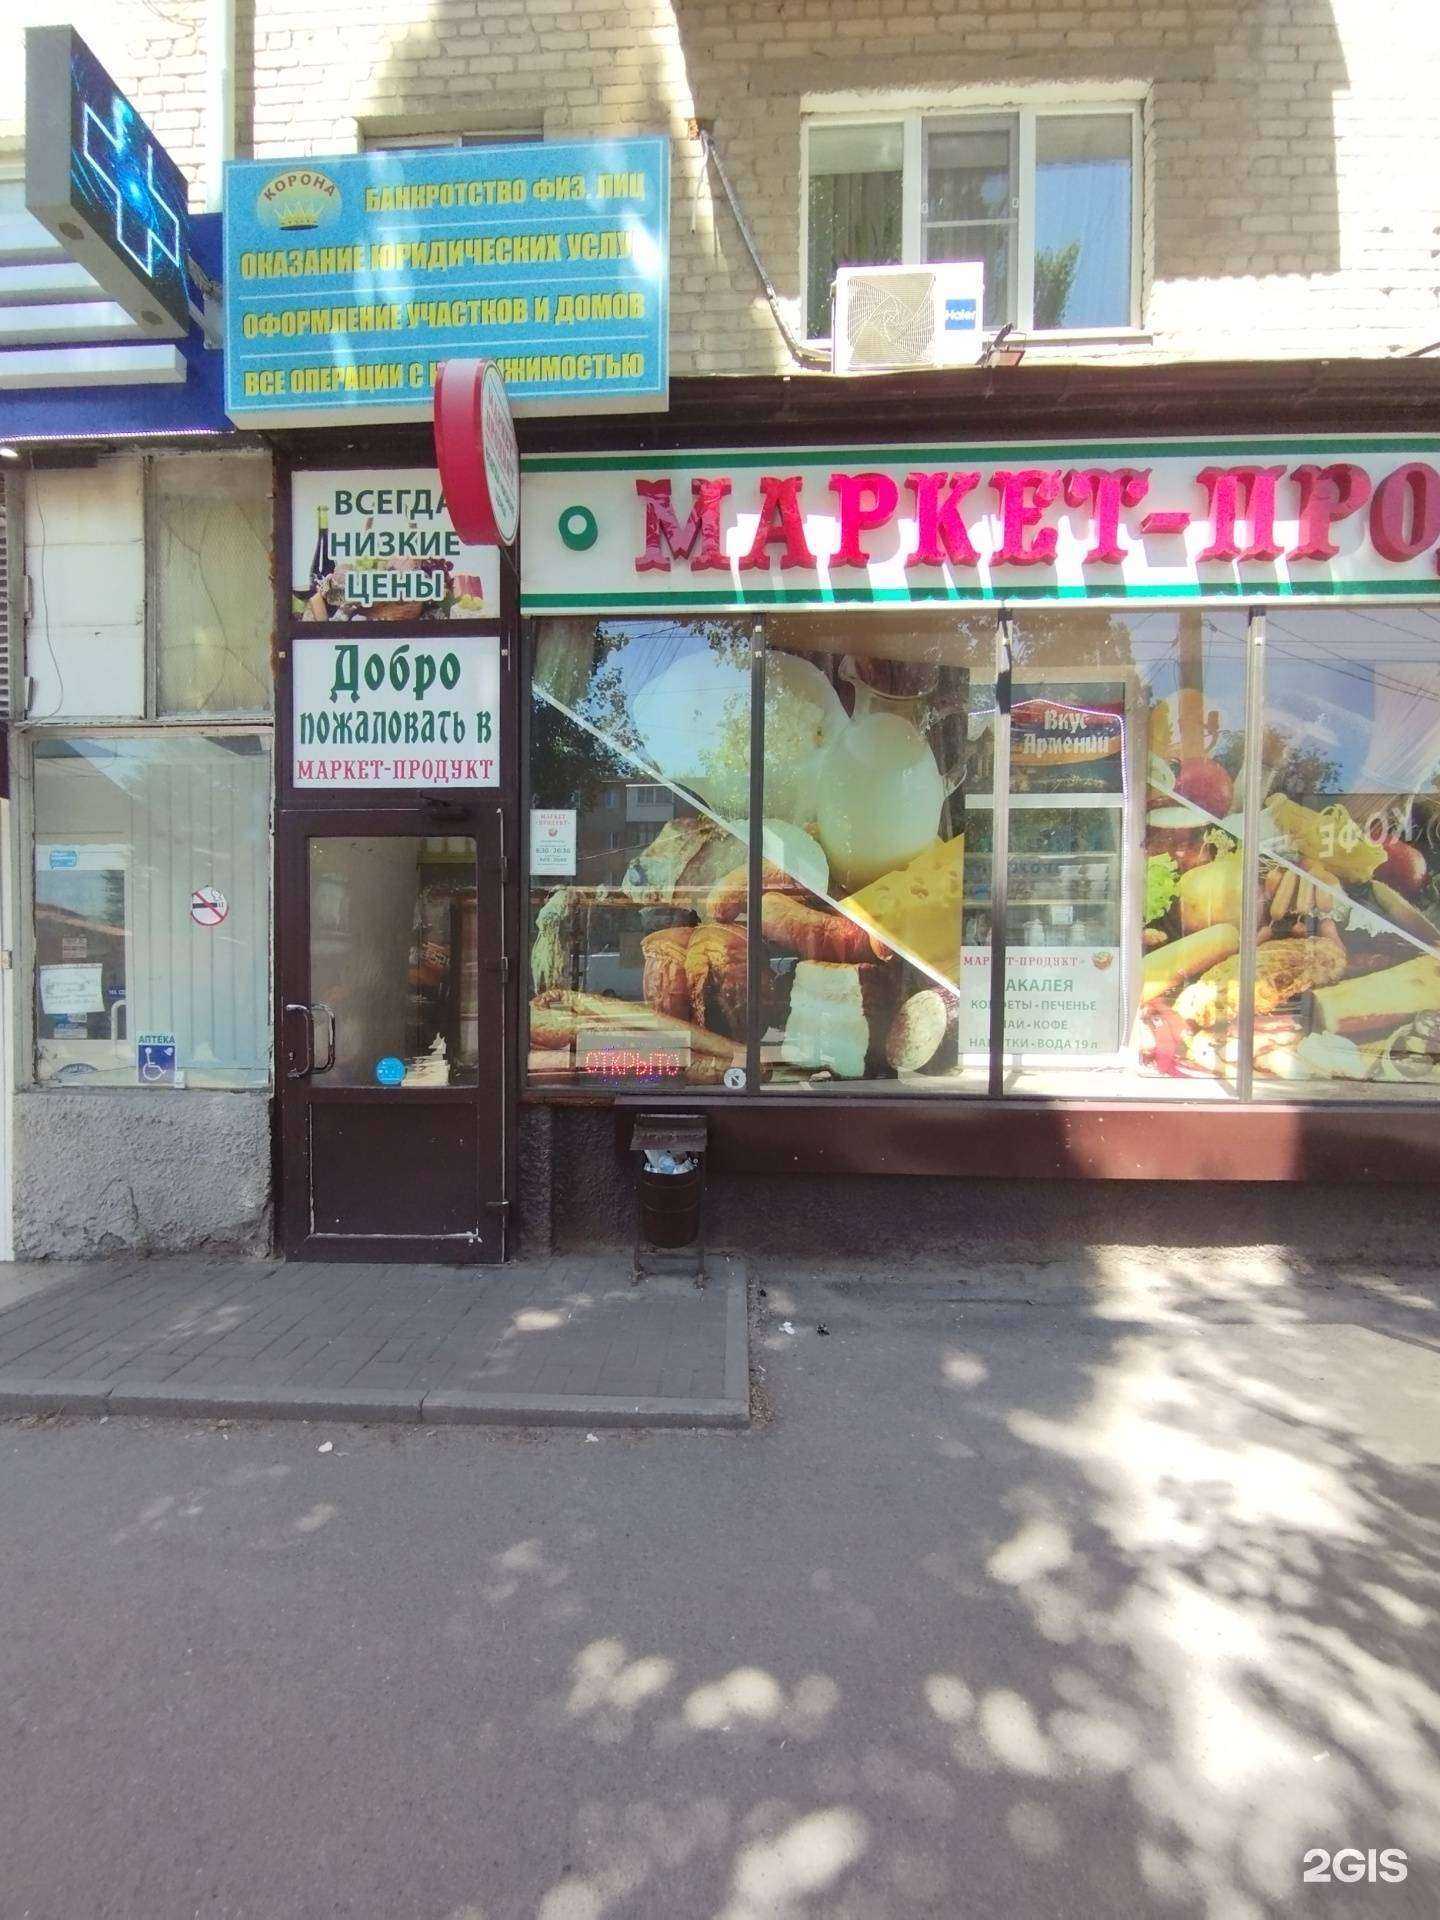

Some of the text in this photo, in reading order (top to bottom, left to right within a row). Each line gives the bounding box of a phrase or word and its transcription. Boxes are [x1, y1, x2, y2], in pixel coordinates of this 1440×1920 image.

[264, 173, 335, 200] КОРОНА
[365, 179, 524, 212] БАНКРОТСТВО
[596, 171, 645, 201] ЛИЦ
[240, 230, 642, 280] ОКАЗАНИЕ ЮРИДИЧЕСКИХ УСЛУ
[243, 292, 645, 339] ОФОРМЛЕНИЕ УЧАСТКОВ И ДОМОВ
[244, 370, 287, 396] ВСЕ
[290, 362, 403, 394] ОПЕРАЦИИ
[408, 361, 424, 389] С
[634, 462, 1440, 574] МАРКЕТ-ПРО
[331, 531, 460, 557] НИЗКИЕ
[347, 573, 440, 604] ЦЕНЫ
[329, 644, 461, 704] Добро
[300, 711, 492, 745] пожаловать в
[1044, 709, 1087, 733] Вкус
[297, 759, 494, 783] МАРКЕТ-ПРОДУКТ
[963, 956, 1079, 968] МАРТ-ПРОДУКТ
[1006, 979, 1074, 992] АКАЛЕЯ
[971, 1000, 1032, 1010] КОЕТЫ
[1004, 1019, 1025, 1030] АЙ
[138, 1034, 176, 1044] АПТЕКА
[970, 1038, 1029, 1048] НАТКИ
